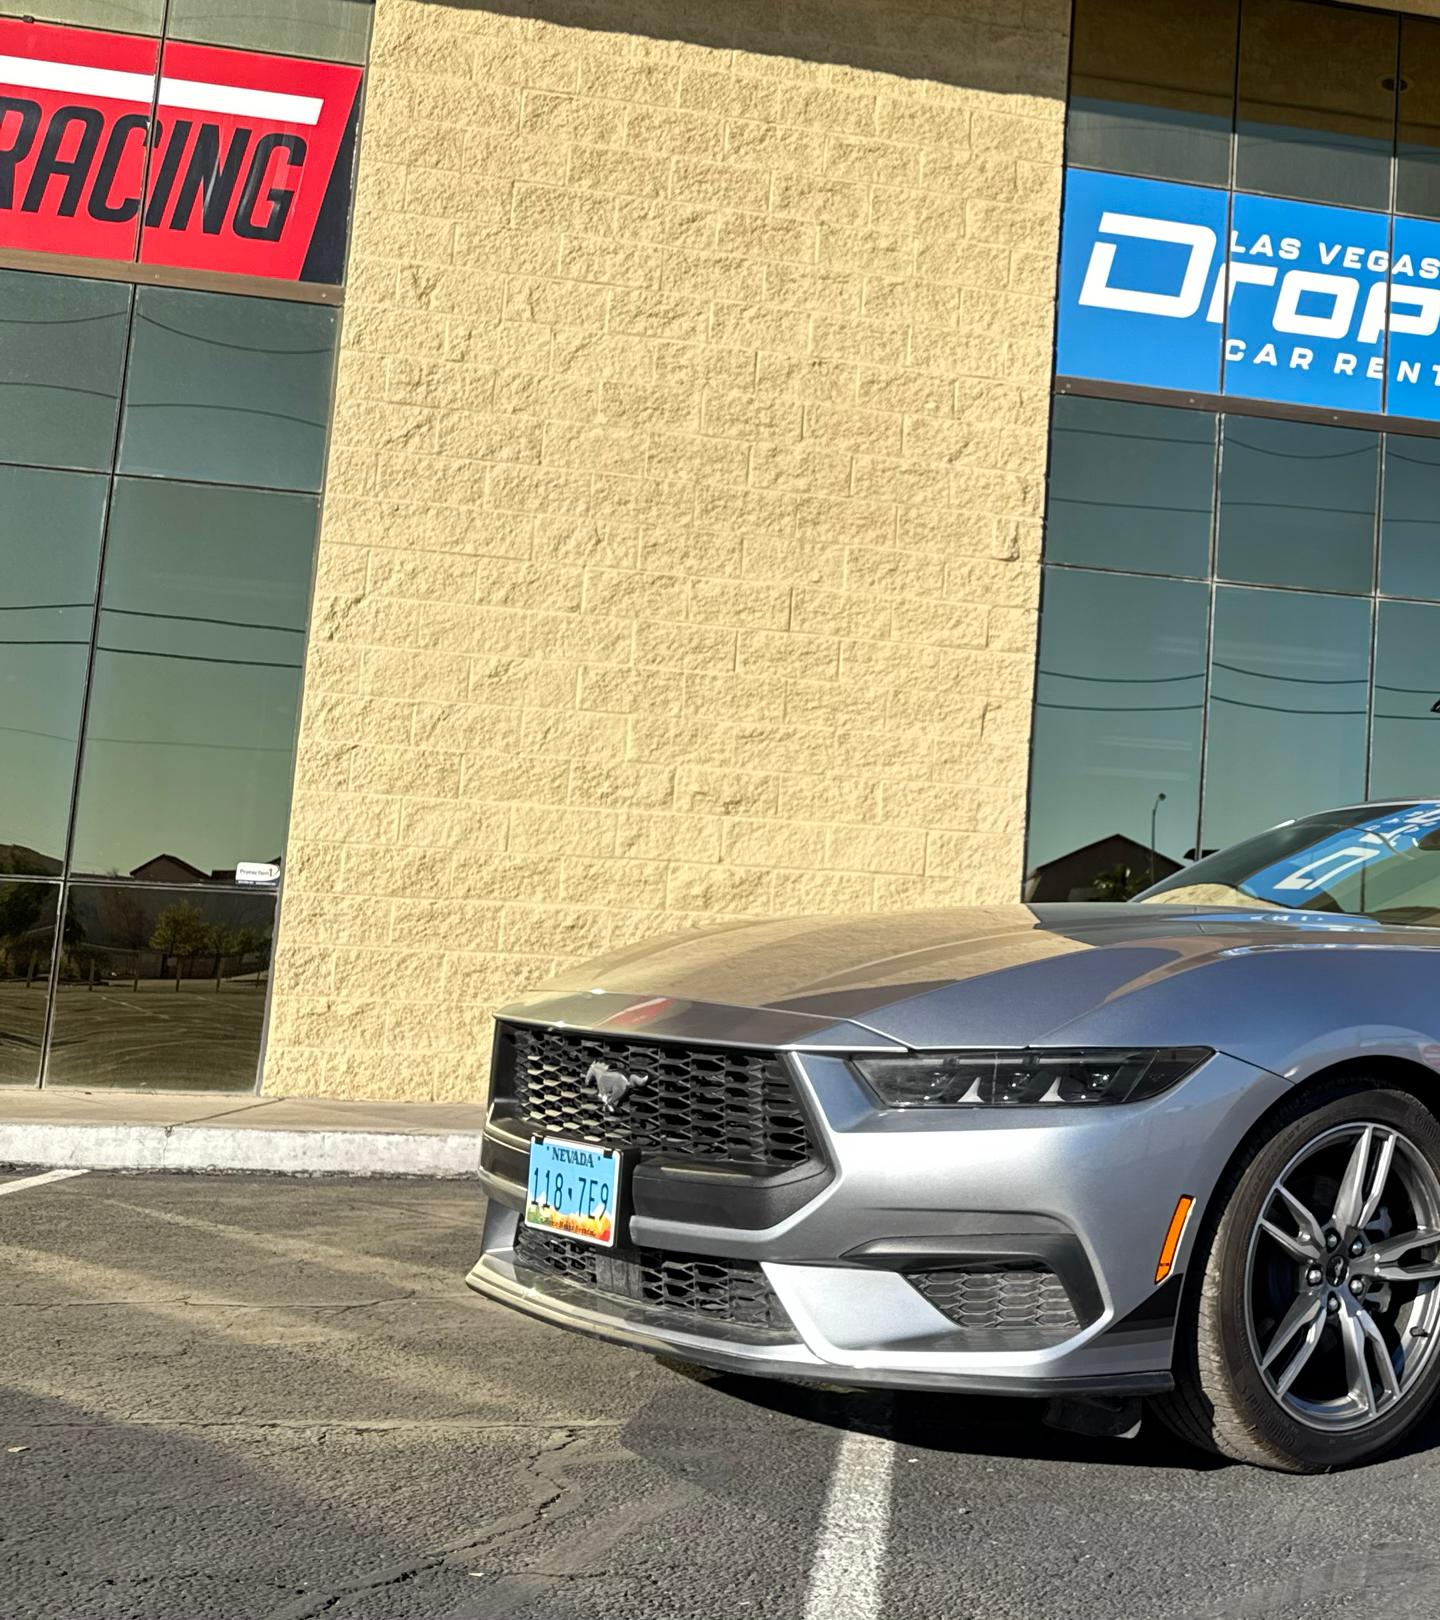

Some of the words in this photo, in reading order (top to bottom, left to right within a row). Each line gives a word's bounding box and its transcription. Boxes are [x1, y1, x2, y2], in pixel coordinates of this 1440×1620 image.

[0, 97, 307, 242] RACING
[1230, 230, 1301, 260] LAS
[1318, 242, 1440, 279] VEGAS
[1225, 338, 1314, 370] CAR
[552, 1147, 594, 1168] NEVADA
[531, 1168, 563, 1212] 118
[578, 1177, 609, 1221] 7E9
